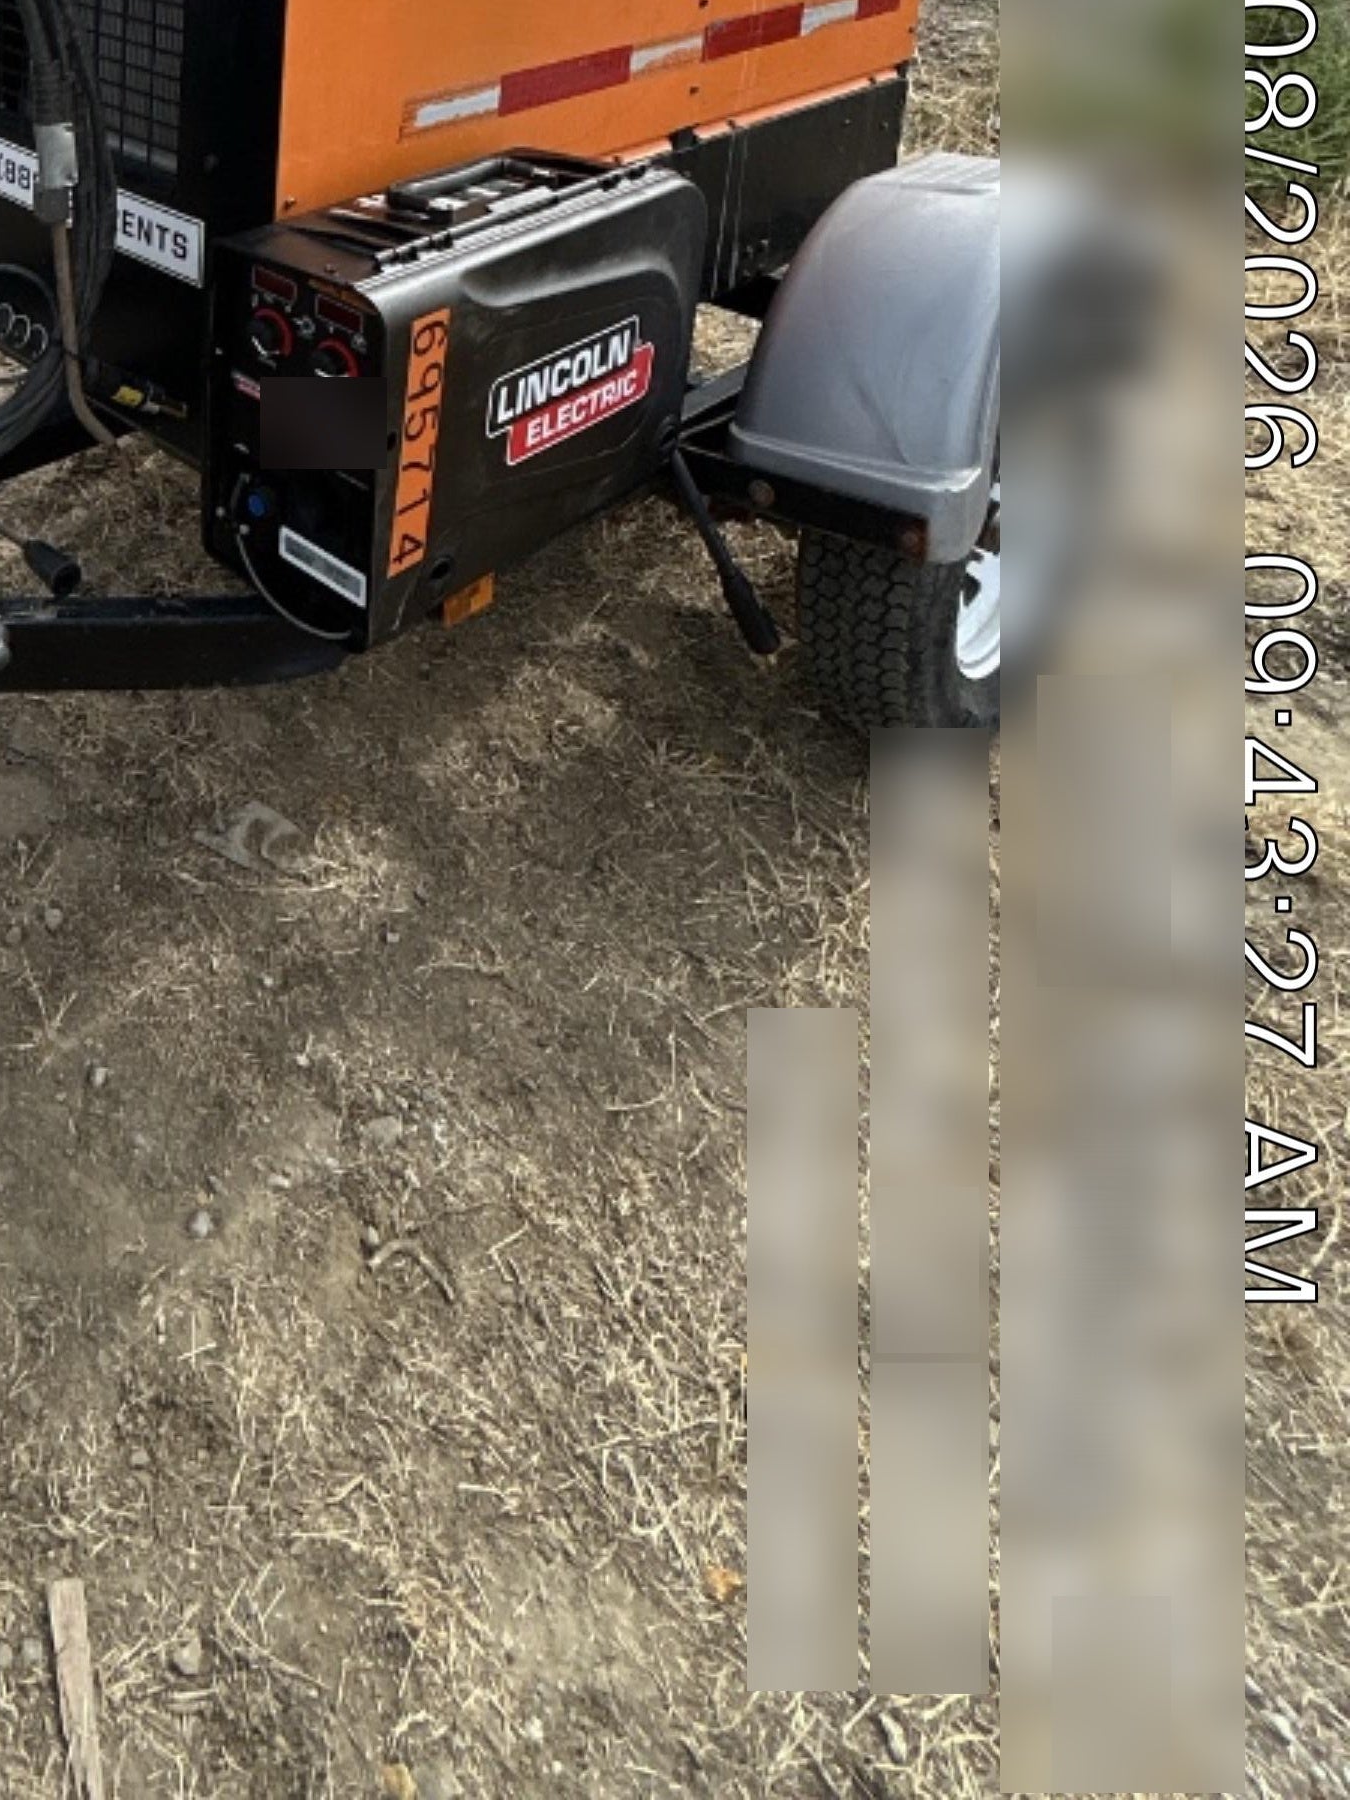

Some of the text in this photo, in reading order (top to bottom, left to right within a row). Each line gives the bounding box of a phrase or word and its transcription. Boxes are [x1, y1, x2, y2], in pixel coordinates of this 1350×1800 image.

[120, 210, 189, 261] ENTS
[497, 328, 632, 423] LINCOLN
[525, 369, 638, 449] ELECTRIC
[391, 319, 447, 566] 695714
